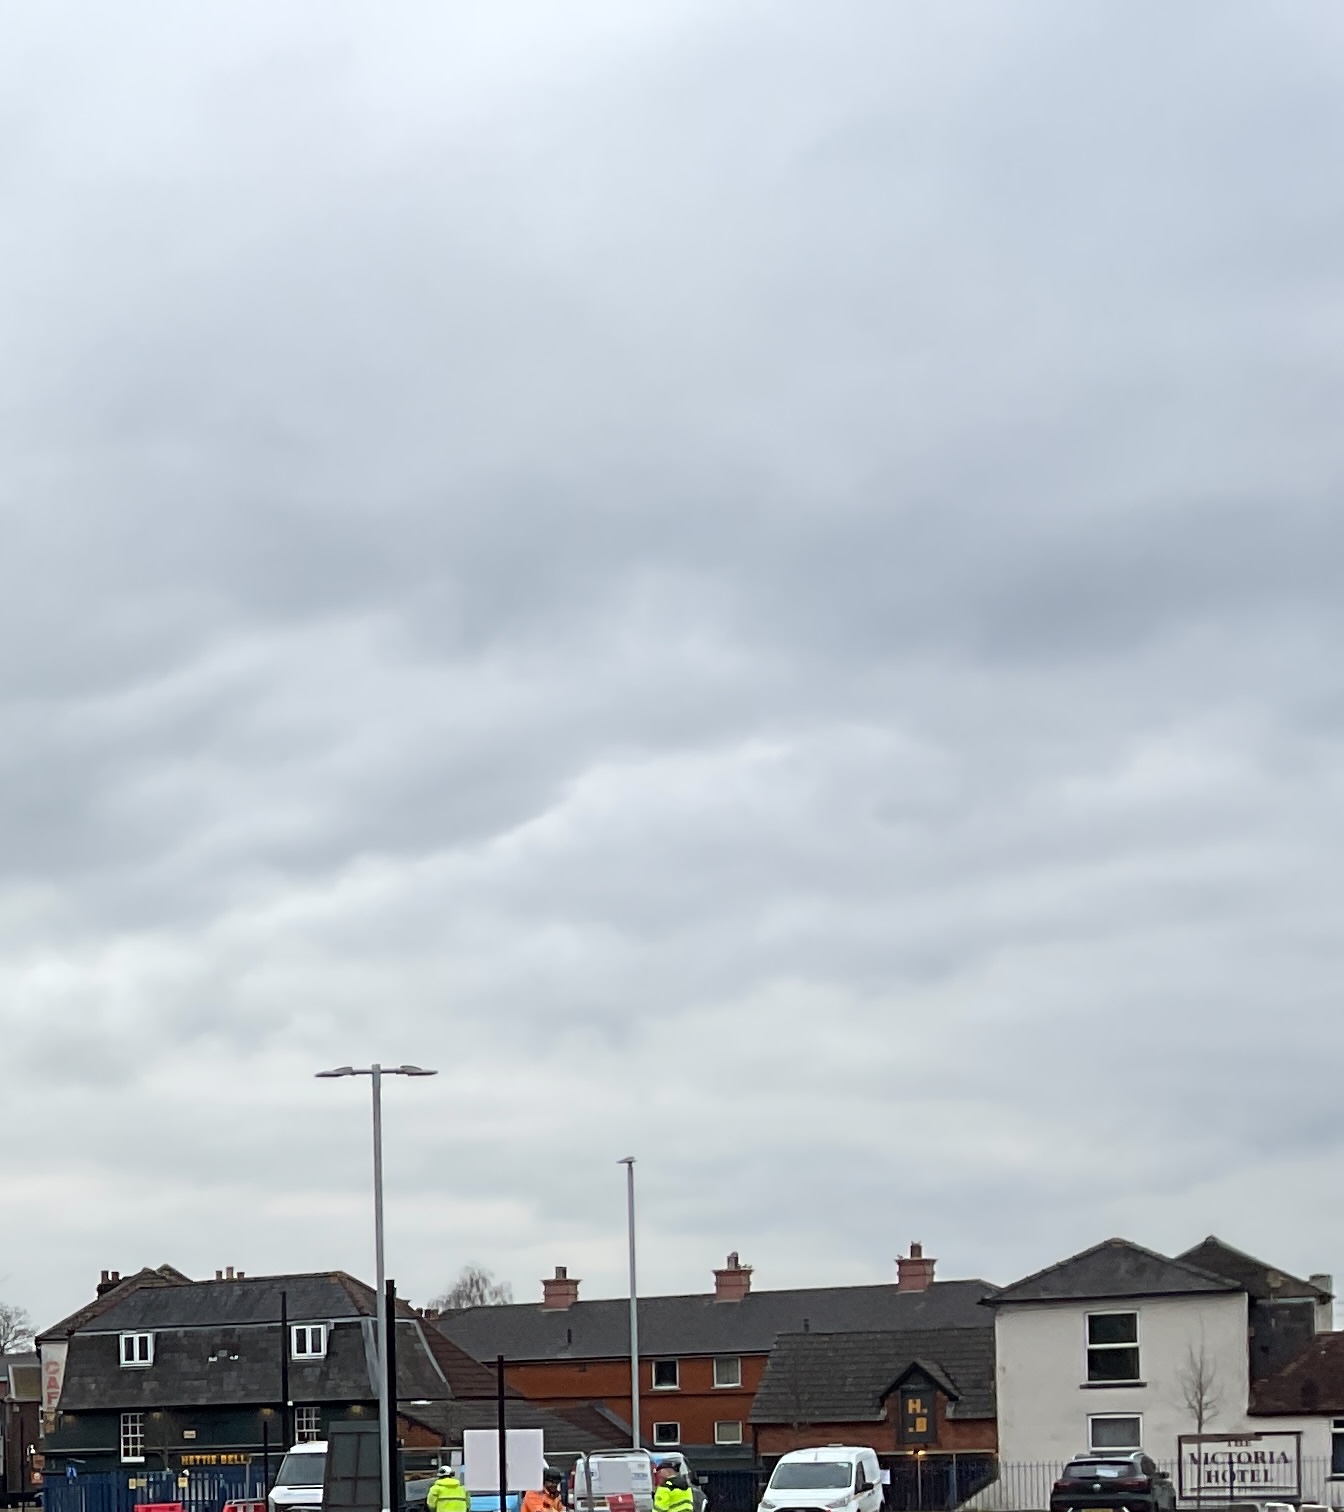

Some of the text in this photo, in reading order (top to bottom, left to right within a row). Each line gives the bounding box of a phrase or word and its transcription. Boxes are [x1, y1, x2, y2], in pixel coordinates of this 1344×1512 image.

[181, 1455, 217, 1466] HETTIE
[1189, 1450, 1290, 1465] VICTORIA
[1205, 1468, 1274, 1485] HOTEL
